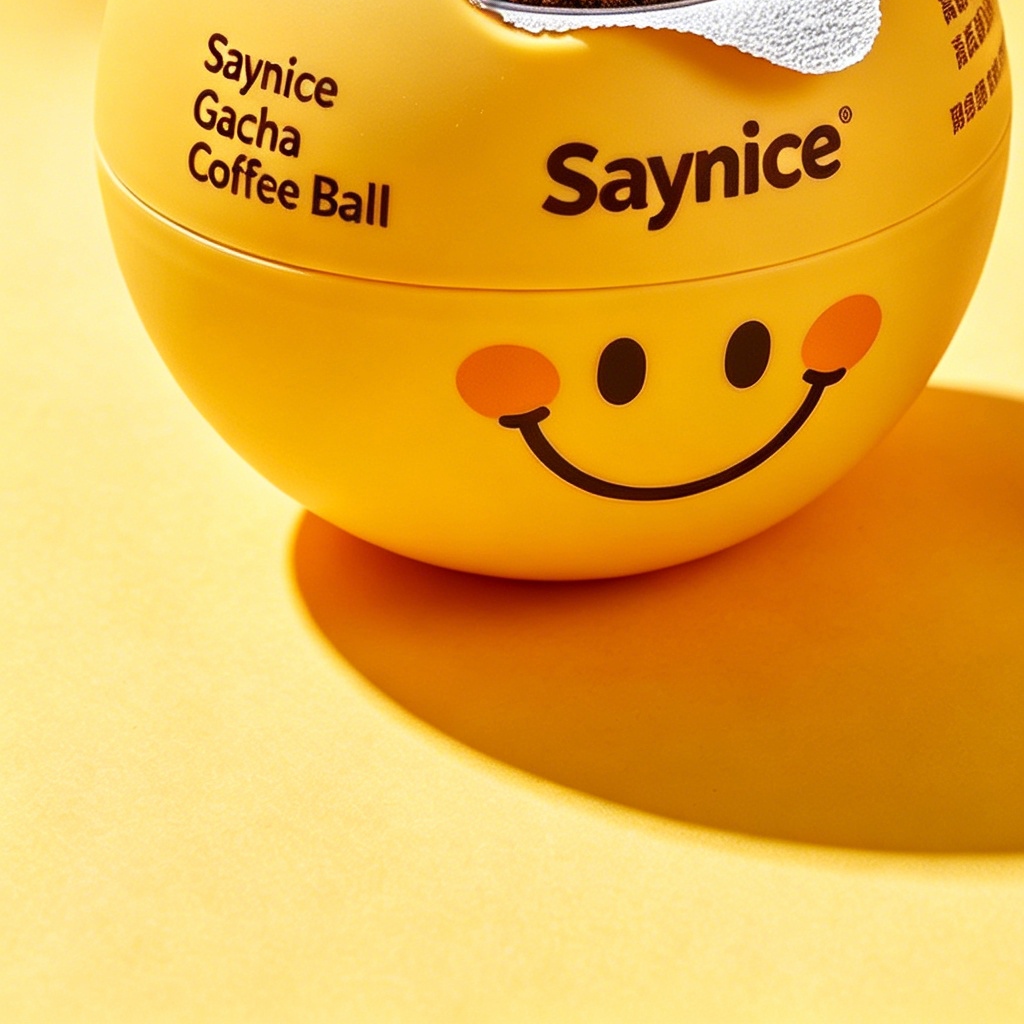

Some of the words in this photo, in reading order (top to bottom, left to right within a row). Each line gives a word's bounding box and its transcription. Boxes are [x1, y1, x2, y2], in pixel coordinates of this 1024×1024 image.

[204, 33, 338, 108] Saynice
[193, 89, 301, 158] Gacha
[188, 141, 300, 210] Coffee
[311, 174, 390, 228] Ball
